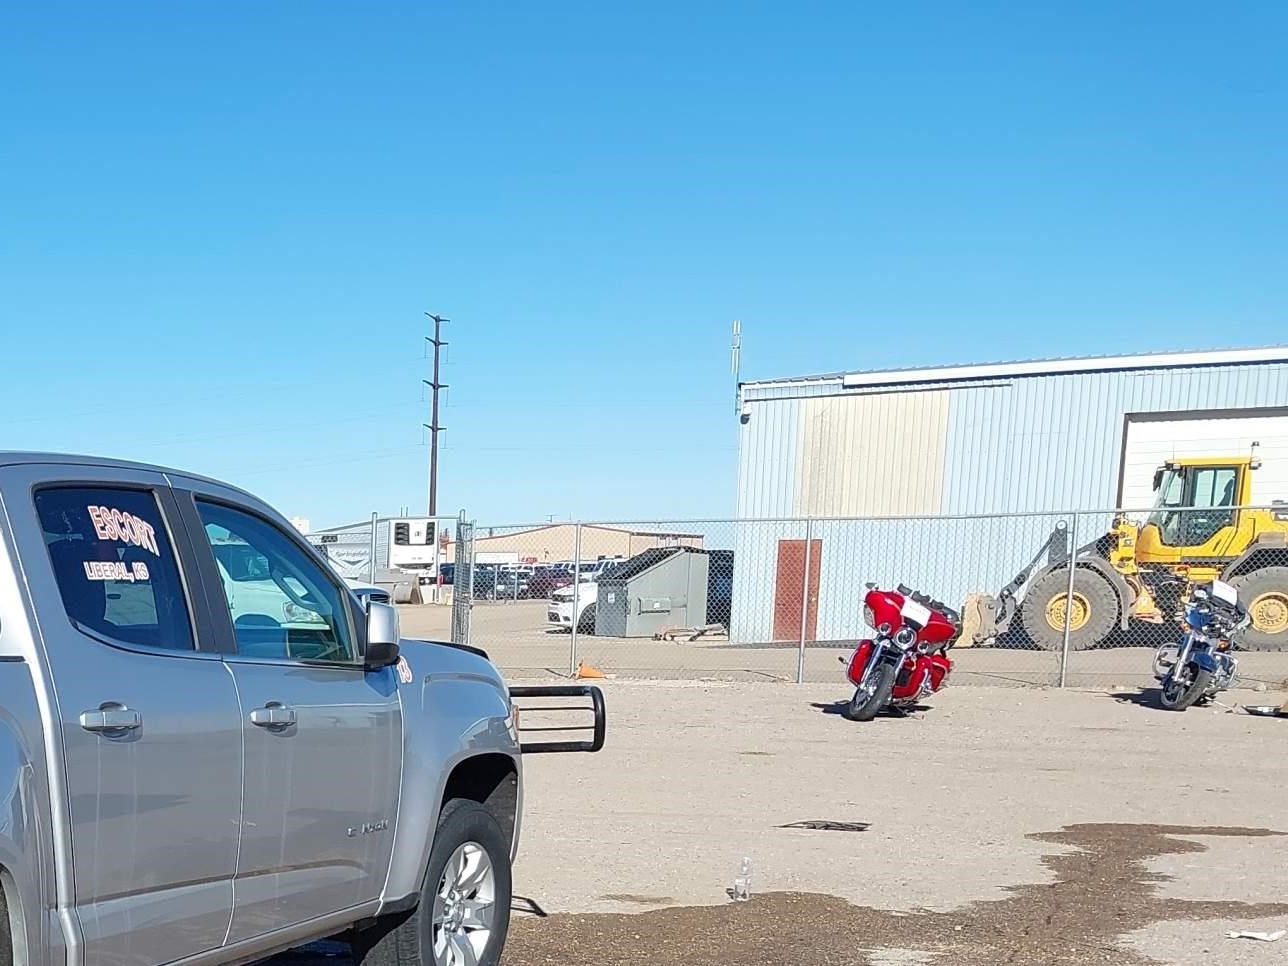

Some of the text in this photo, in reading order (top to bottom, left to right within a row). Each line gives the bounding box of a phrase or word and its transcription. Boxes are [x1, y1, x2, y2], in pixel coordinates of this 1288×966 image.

[88, 506, 160, 556] ESCORT
[83, 562, 150, 582] LIBERAL, KS
